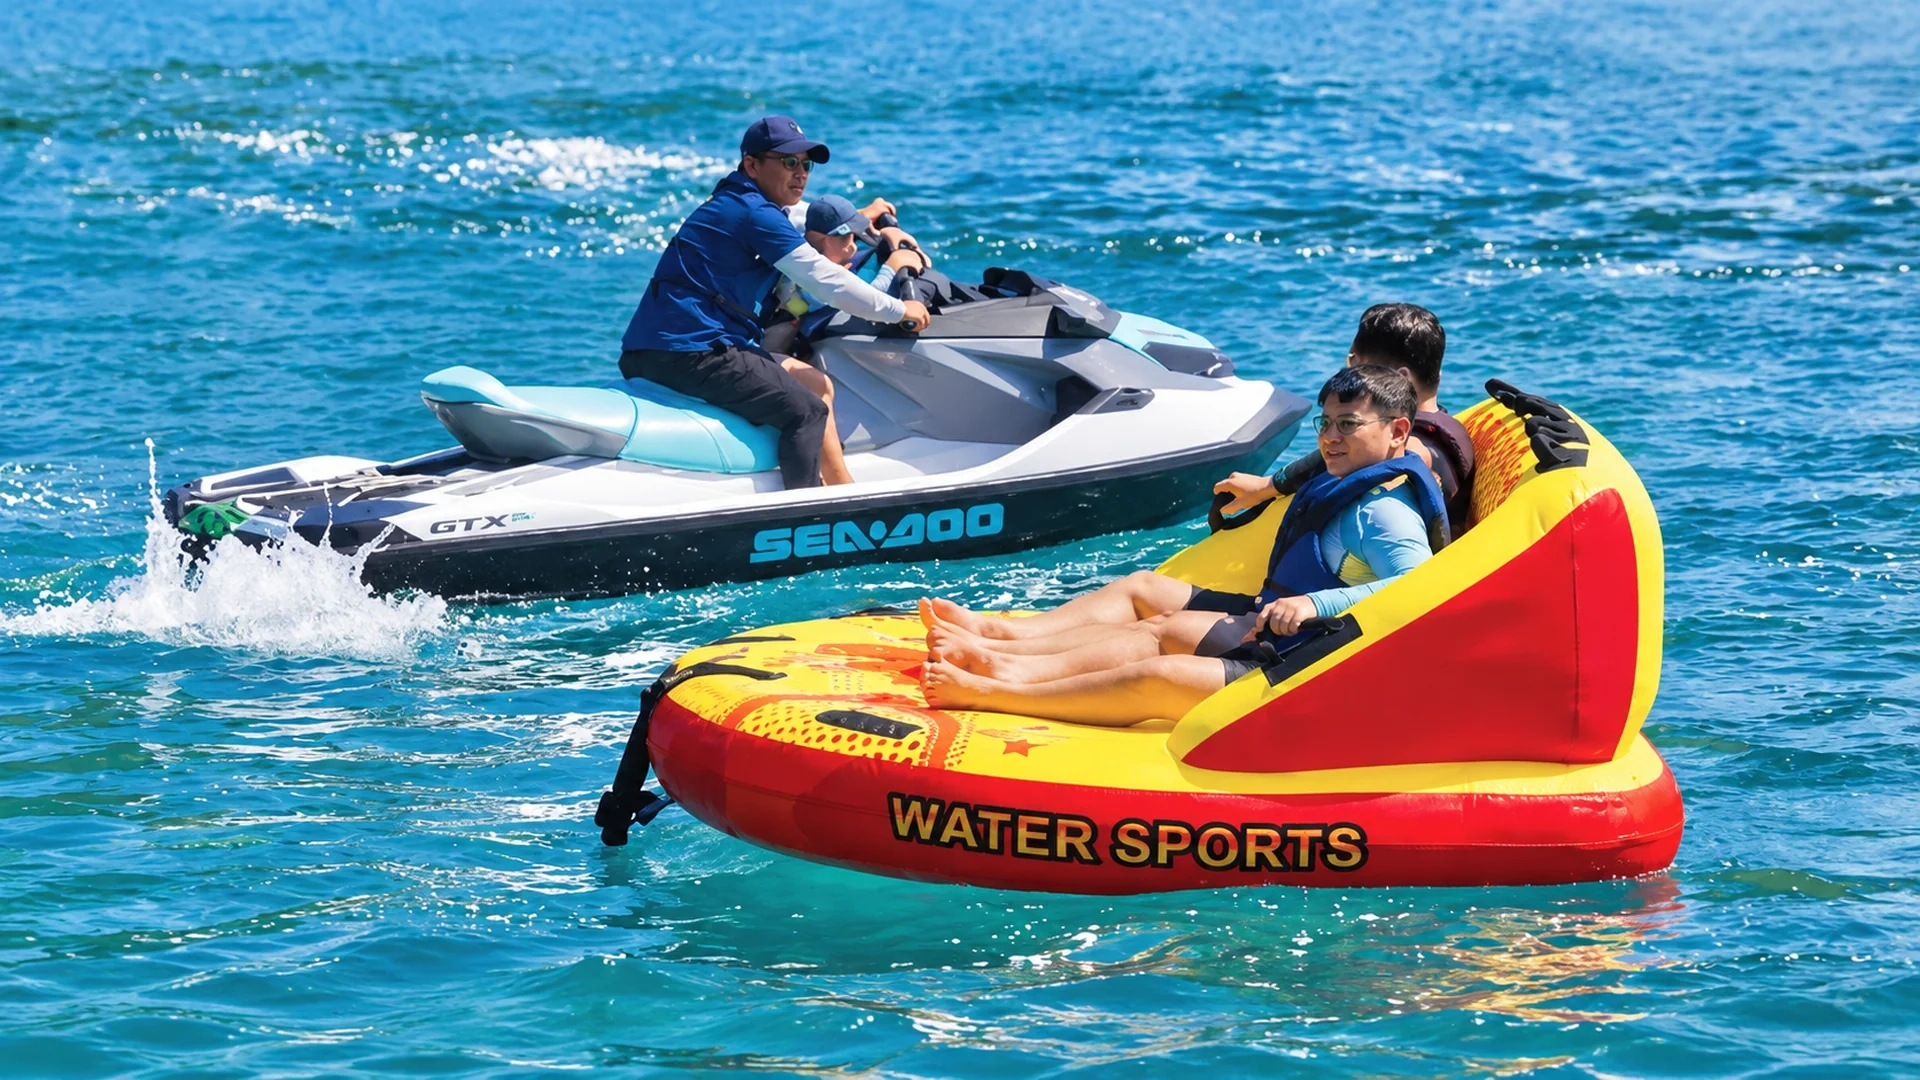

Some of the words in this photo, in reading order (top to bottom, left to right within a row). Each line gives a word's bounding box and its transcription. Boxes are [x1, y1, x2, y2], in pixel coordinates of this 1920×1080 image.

[430, 514, 509, 534] GTX
[889, 794, 1100, 863] WATER
[1112, 820, 1367, 871] SPORTS
